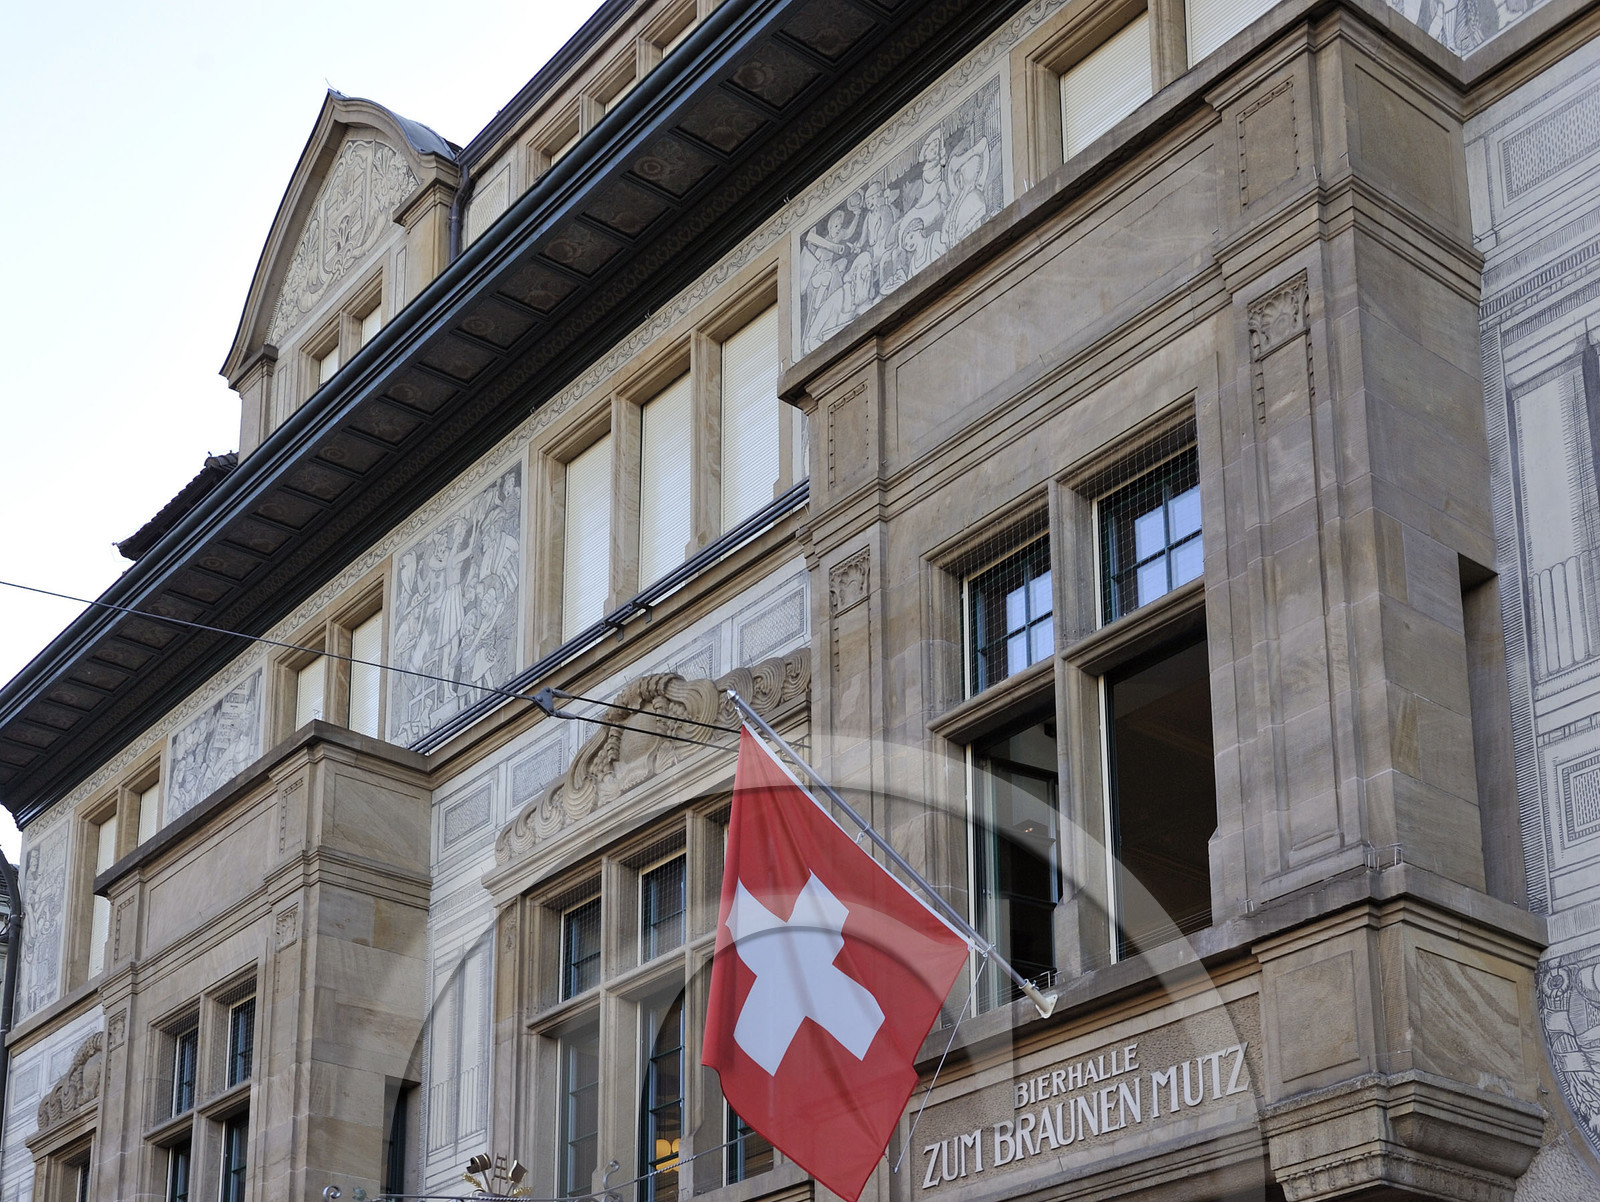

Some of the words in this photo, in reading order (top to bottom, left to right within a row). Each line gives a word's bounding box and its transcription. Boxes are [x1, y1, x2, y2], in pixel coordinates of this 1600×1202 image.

[922, 1129, 984, 1189] ZUM
[993, 1077, 1142, 1168] BRAUNEN
[1151, 1042, 1249, 1120] MUTZ
[1014, 1043, 1139, 1109] BIERHALLE
